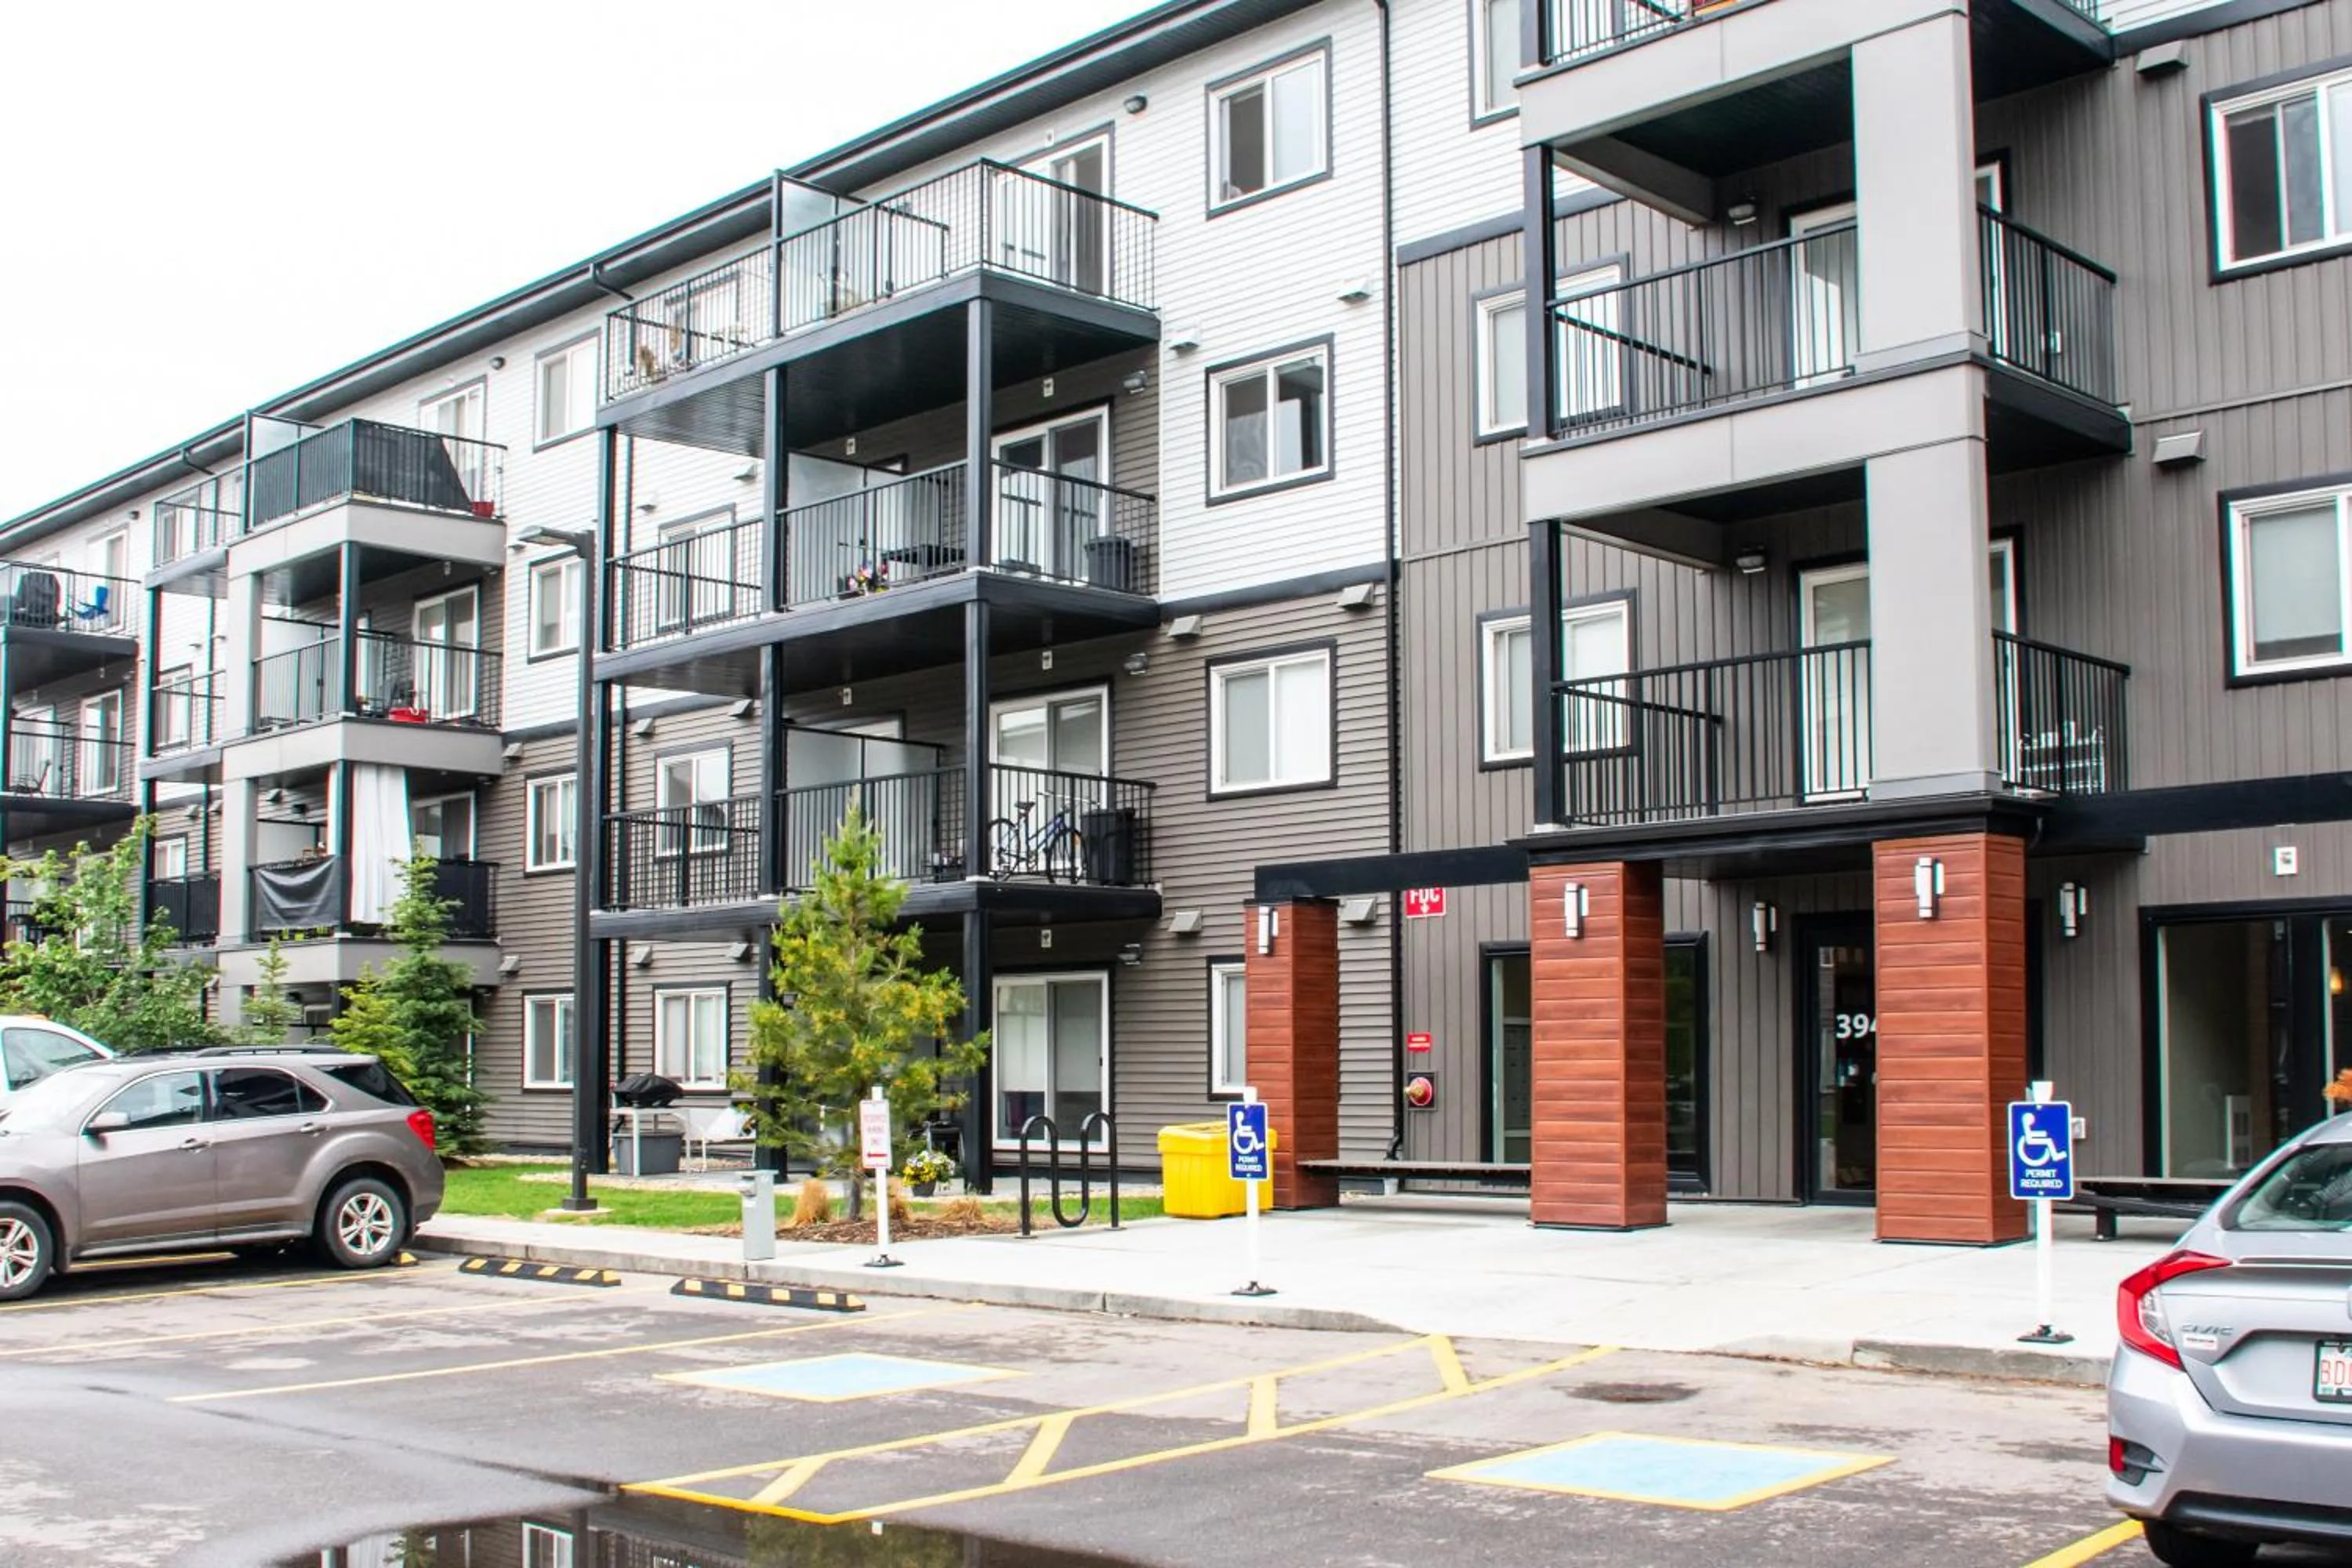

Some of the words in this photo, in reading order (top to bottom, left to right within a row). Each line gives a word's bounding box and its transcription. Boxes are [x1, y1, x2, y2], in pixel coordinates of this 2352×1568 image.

[2025, 1169, 2057, 1178] PERMIT
[2020, 1178, 2063, 1189] REQUIRED
[2180, 1324, 2234, 1336] CIVIC
[2320, 1359, 2352, 1385] BD
